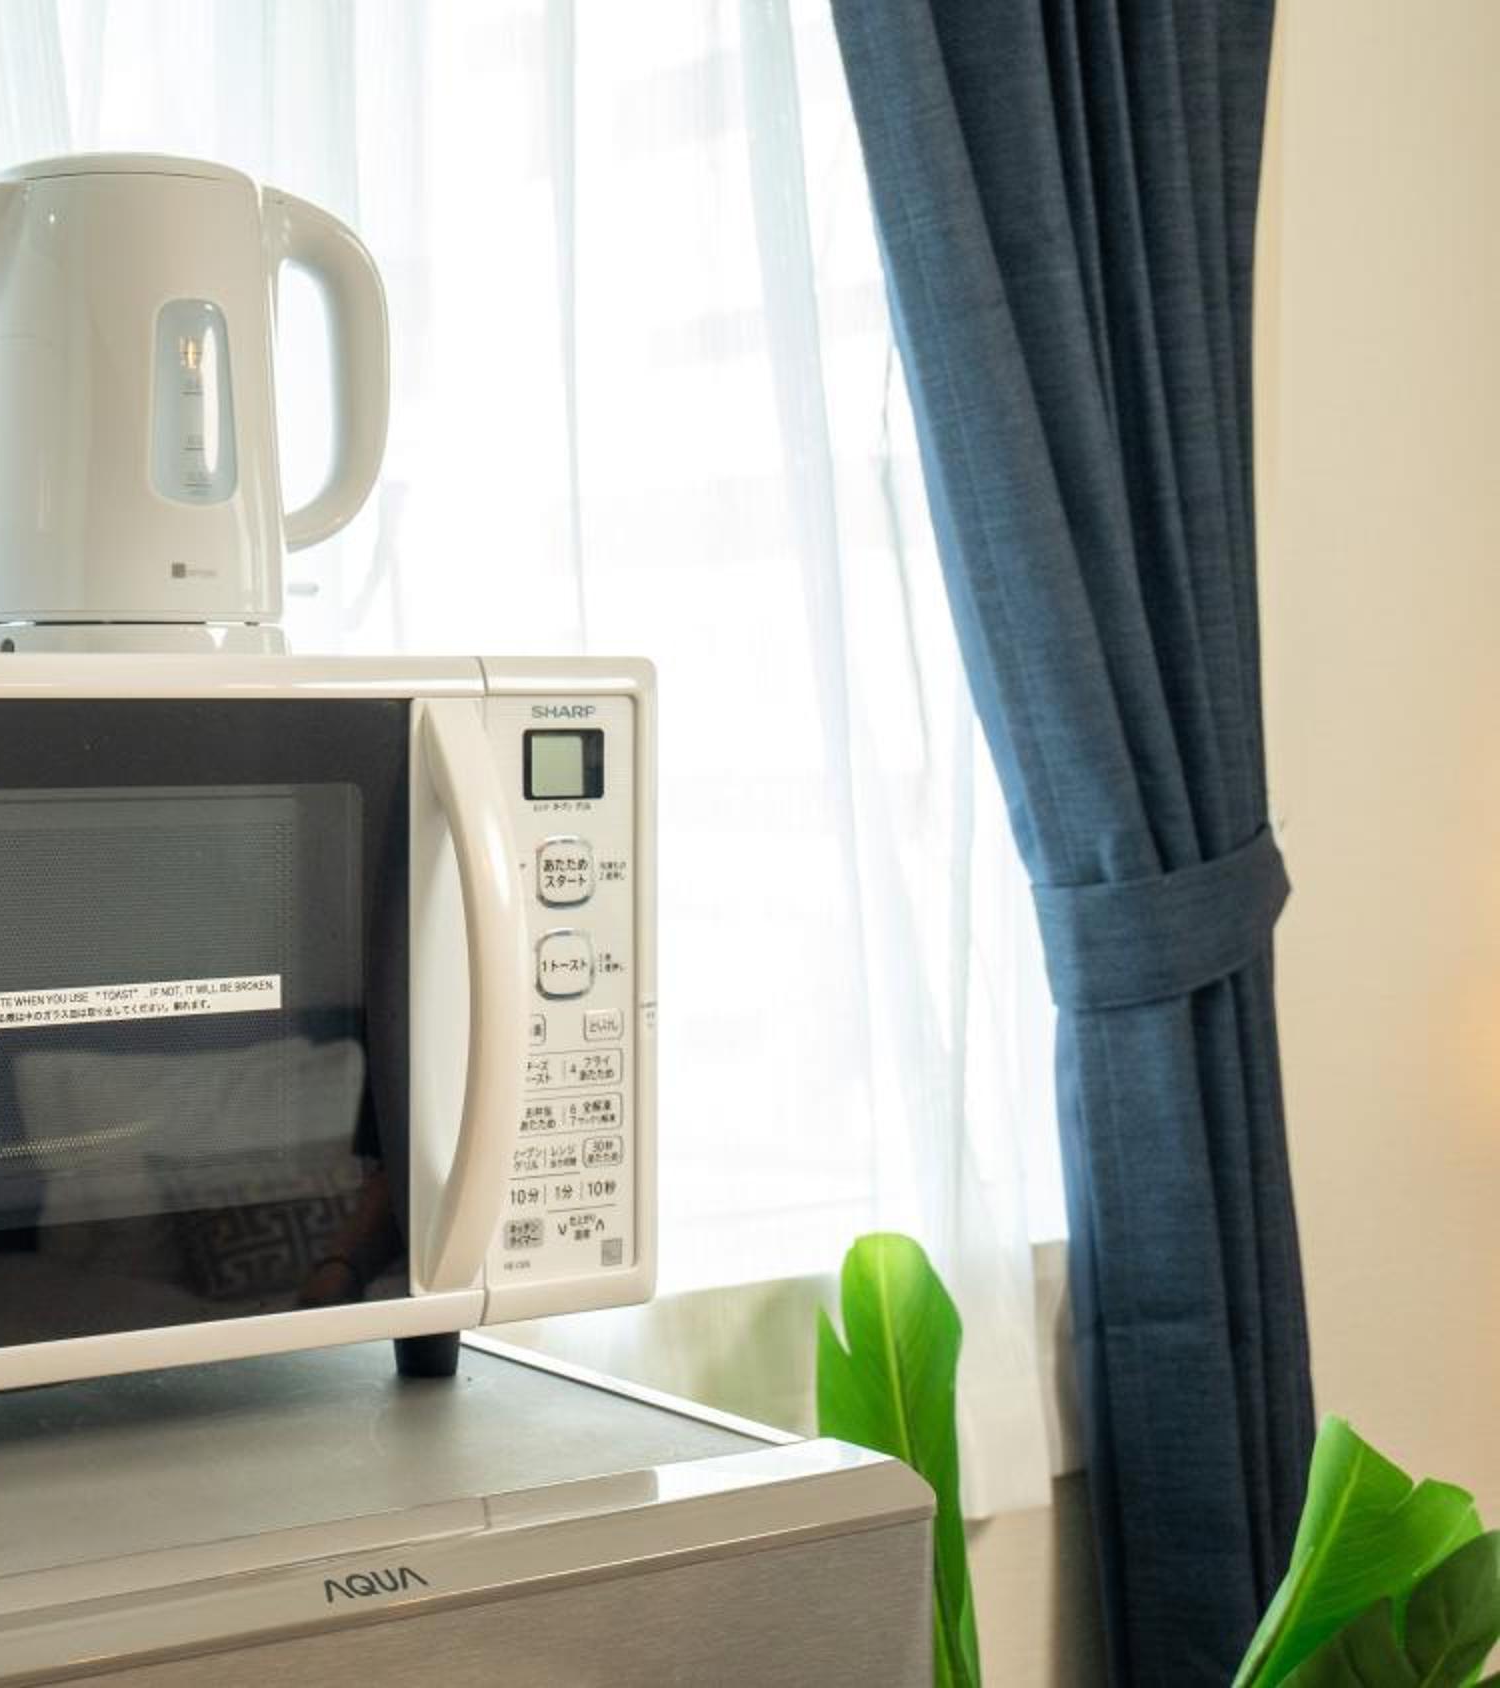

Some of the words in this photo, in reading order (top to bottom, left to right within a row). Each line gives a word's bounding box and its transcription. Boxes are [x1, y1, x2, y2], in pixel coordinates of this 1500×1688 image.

[531, 704, 596, 719] SHARP
[543, 858, 588, 873] あたため
[544, 874, 587, 888] スタート
[14, 995, 44, 1007] WHEN
[45, 993, 67, 1005] YOU
[69, 991, 88, 1003] USE
[186, 984, 193, 995] IT
[195, 983, 218, 995] WILL
[584, 1056, 611, 1069] フライ
[580, 1069, 615, 1081] あたため
[520, 1119, 556, 1132] あたため
[551, 1144, 576, 1157] レンジ
[555, 1184, 573, 1199] 1分
[588, 1180, 617, 1197] 10秒
[511, 1188, 540, 1205] 10分
[324, 1567, 429, 1603] AQUA
